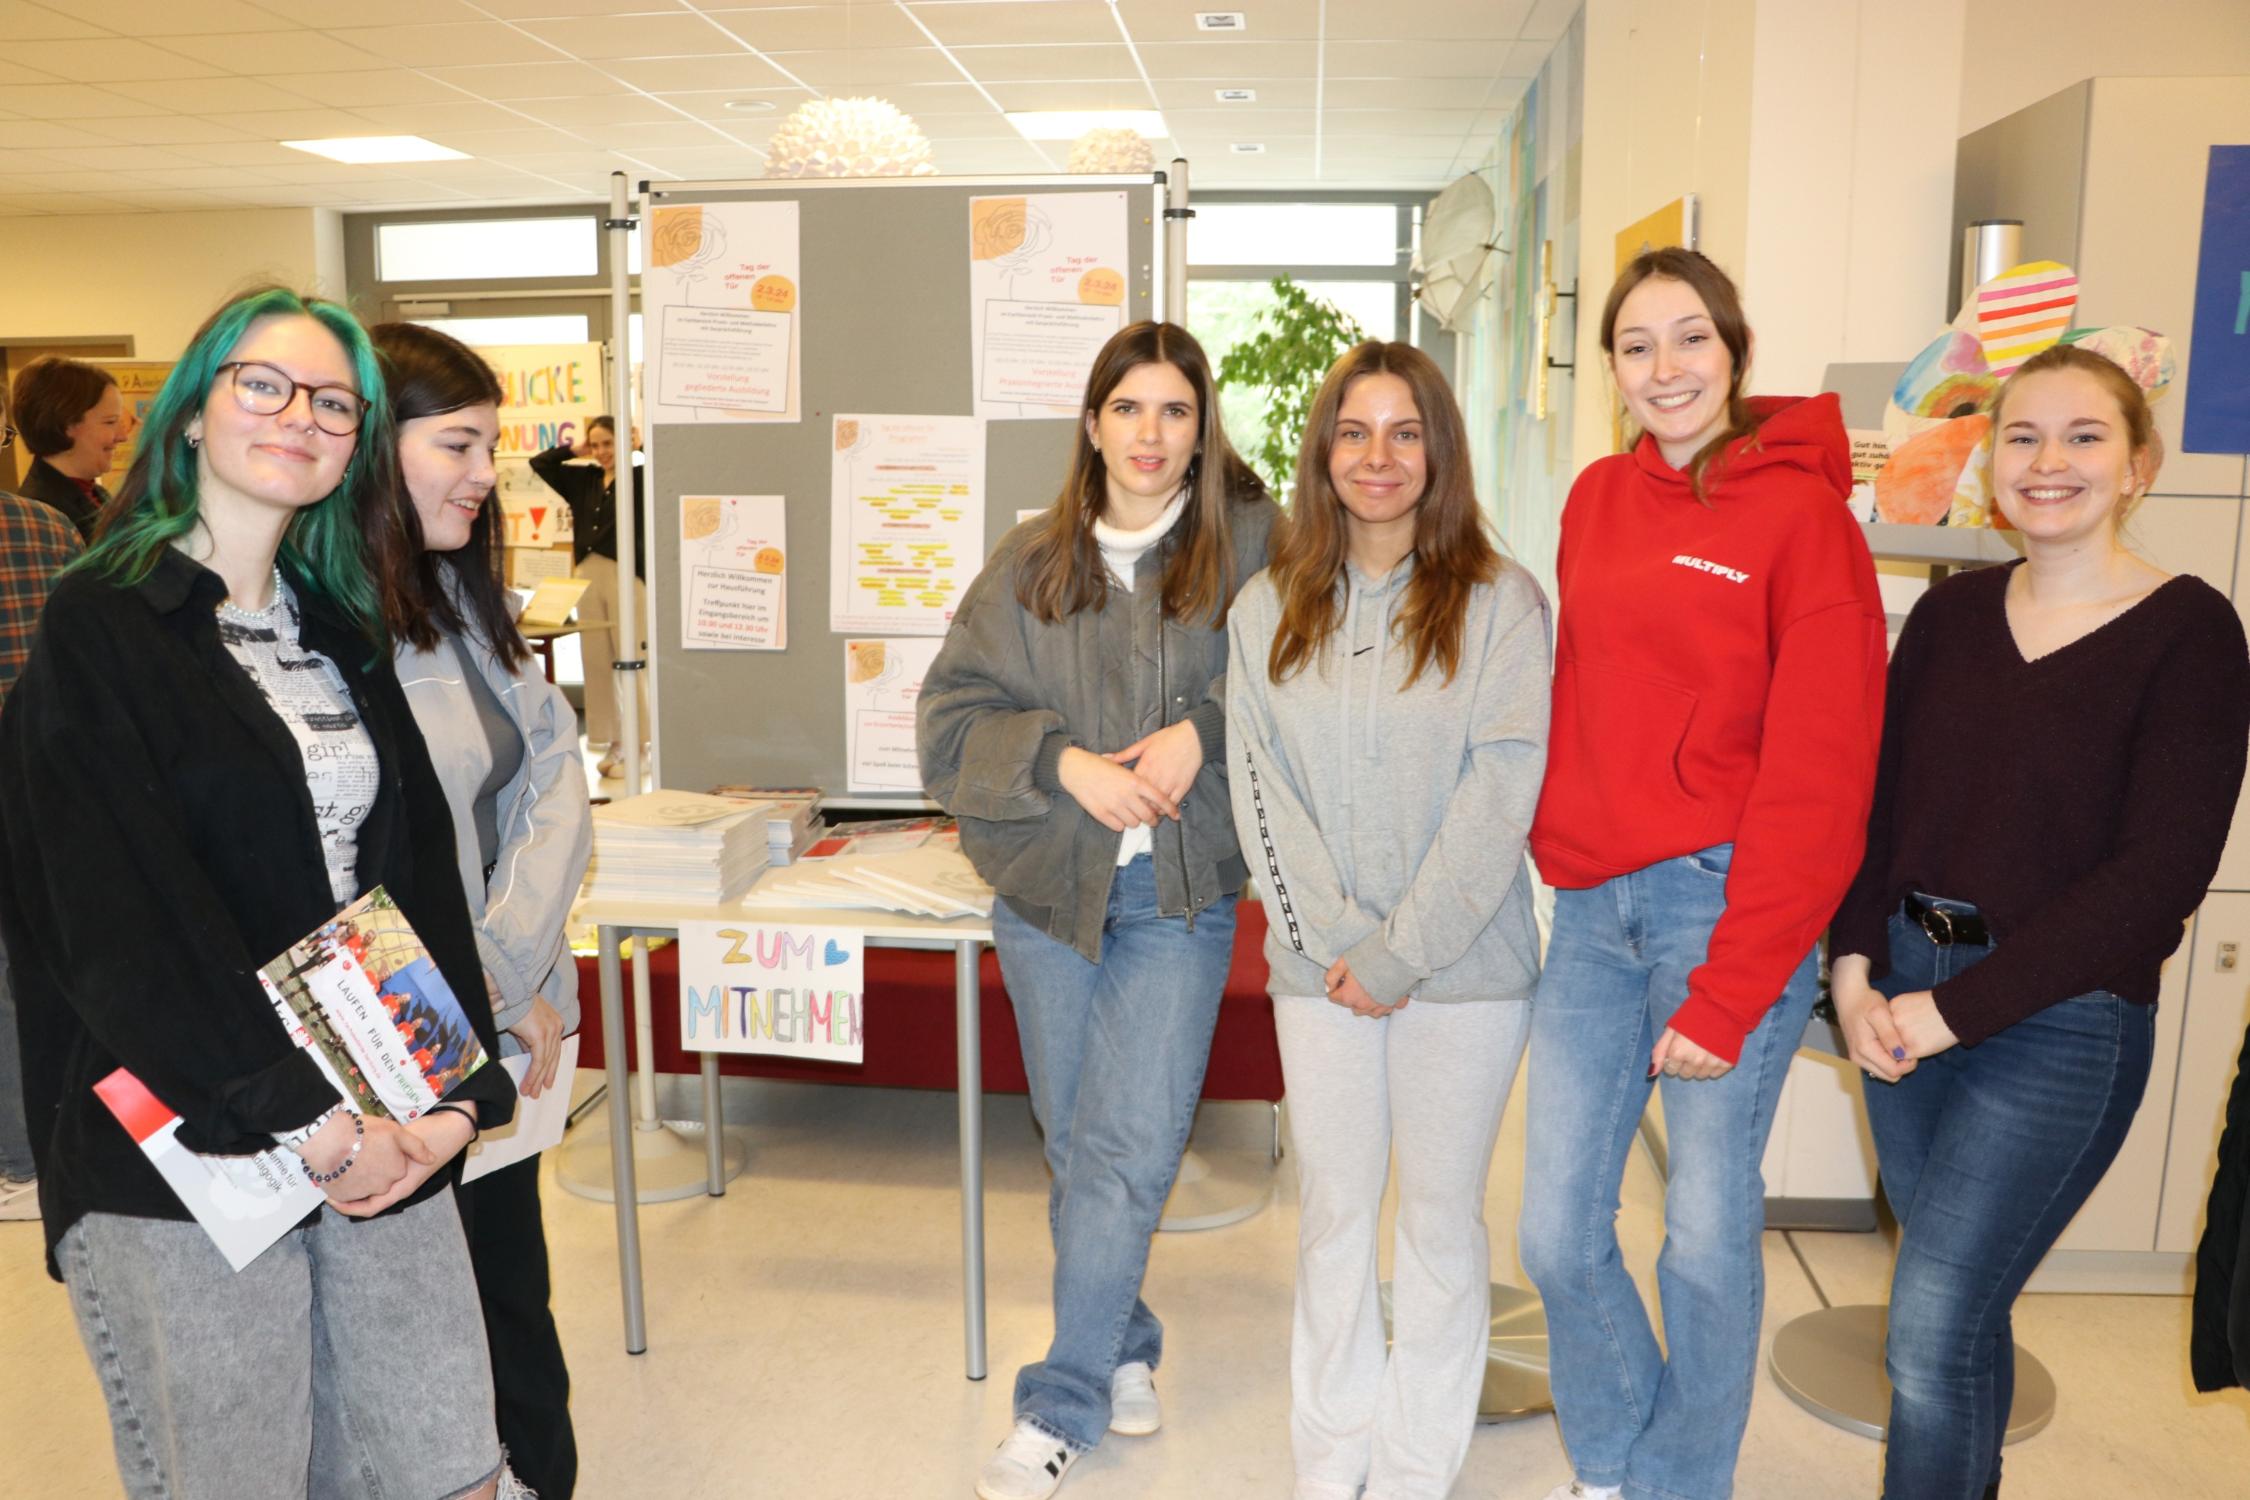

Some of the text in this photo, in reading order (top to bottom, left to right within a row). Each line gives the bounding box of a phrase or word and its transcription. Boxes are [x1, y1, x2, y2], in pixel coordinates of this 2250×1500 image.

[738, 262, 770, 271] Tag der
[697, 570, 772, 583] Herzlich Willkommen
[1671, 554, 1751, 584] MULTIPLY
[716, 928, 815, 971] ZUM
[336, 978, 369, 1022] LAUFEN
[367, 1026, 384, 1051] FÜR
[381, 1052, 396, 1073] DEN
